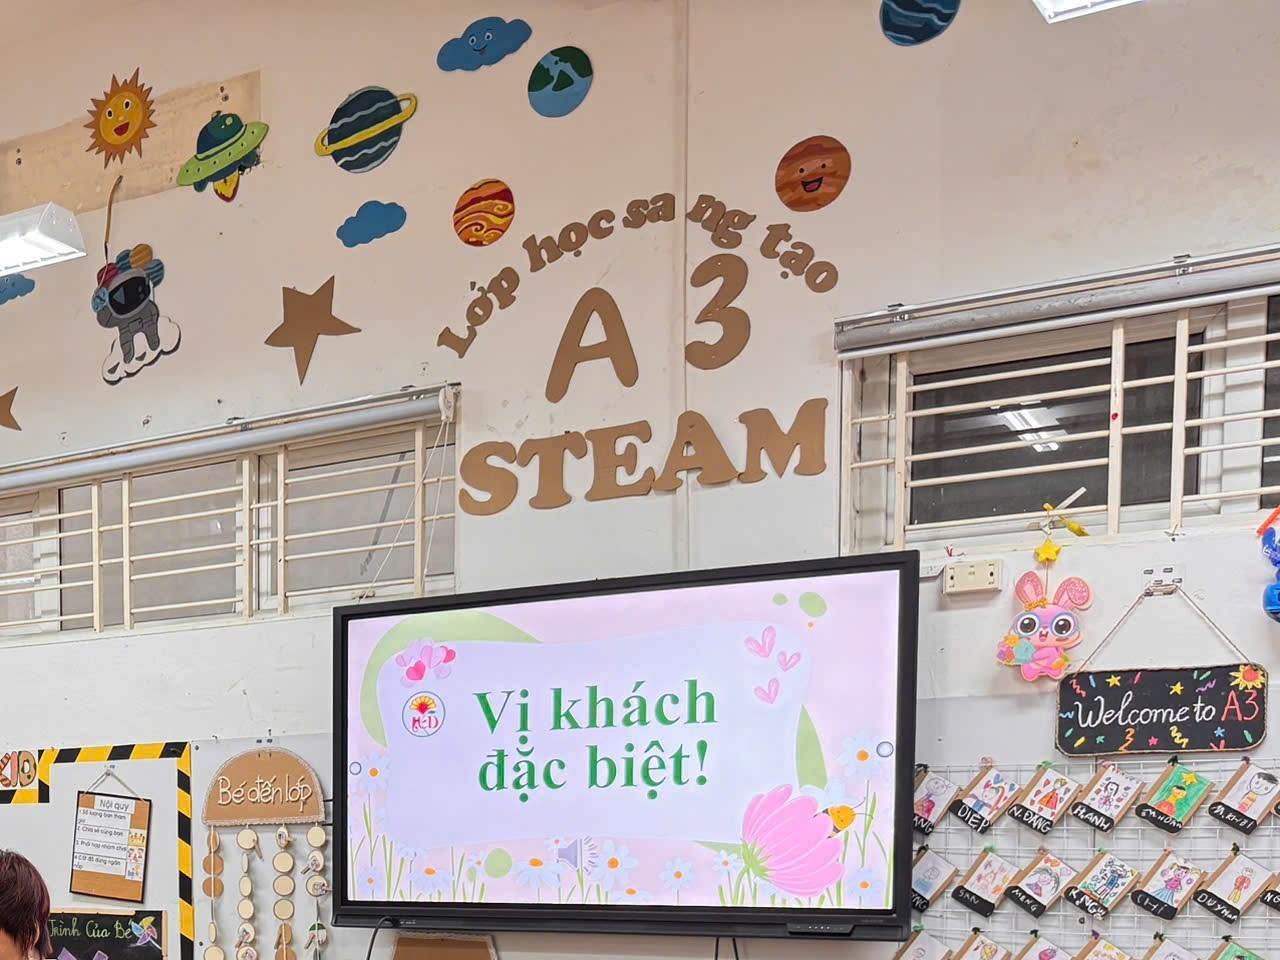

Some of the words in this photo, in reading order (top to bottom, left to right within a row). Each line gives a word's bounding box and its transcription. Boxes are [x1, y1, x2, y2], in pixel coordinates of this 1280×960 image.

[522, 209, 615, 273] học
[760, 223, 839, 293] tạo
[458, 398, 828, 516] STEAM
[473, 689, 530, 744] Vị
[550, 678, 719, 732] khách
[1074, 690, 1190, 728] Welcome
[1193, 696, 1216, 722] to
[1221, 689, 1260, 722] A3
[217, 775, 247, 805] Bé
[478, 745, 566, 803] đặc
[587, 739, 709, 800] biệt!
[99, 799, 112, 809] Nội
[86, 920, 111, 938] Của
